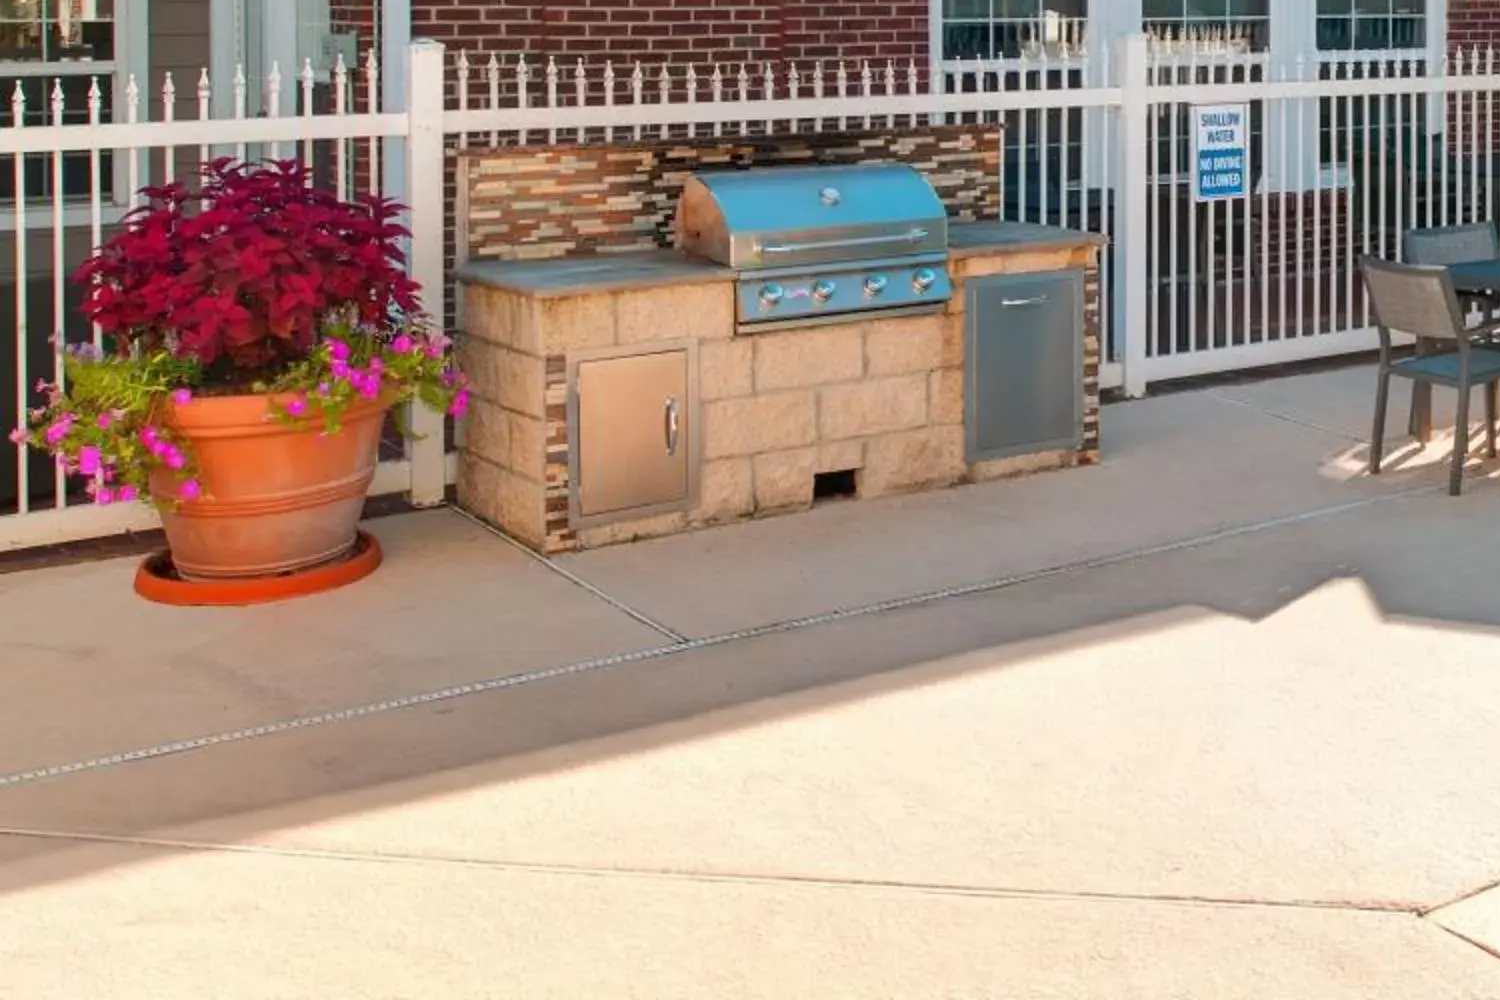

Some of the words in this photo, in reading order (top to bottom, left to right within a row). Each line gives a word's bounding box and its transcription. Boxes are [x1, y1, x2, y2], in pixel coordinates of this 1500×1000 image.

[1201, 112, 1240, 127] SHALLOW
[1207, 129, 1235, 143] WATER
[1200, 157, 1212, 170] NO
[1213, 155, 1241, 169] DIVING
[1202, 173, 1240, 189] ALLOWED
